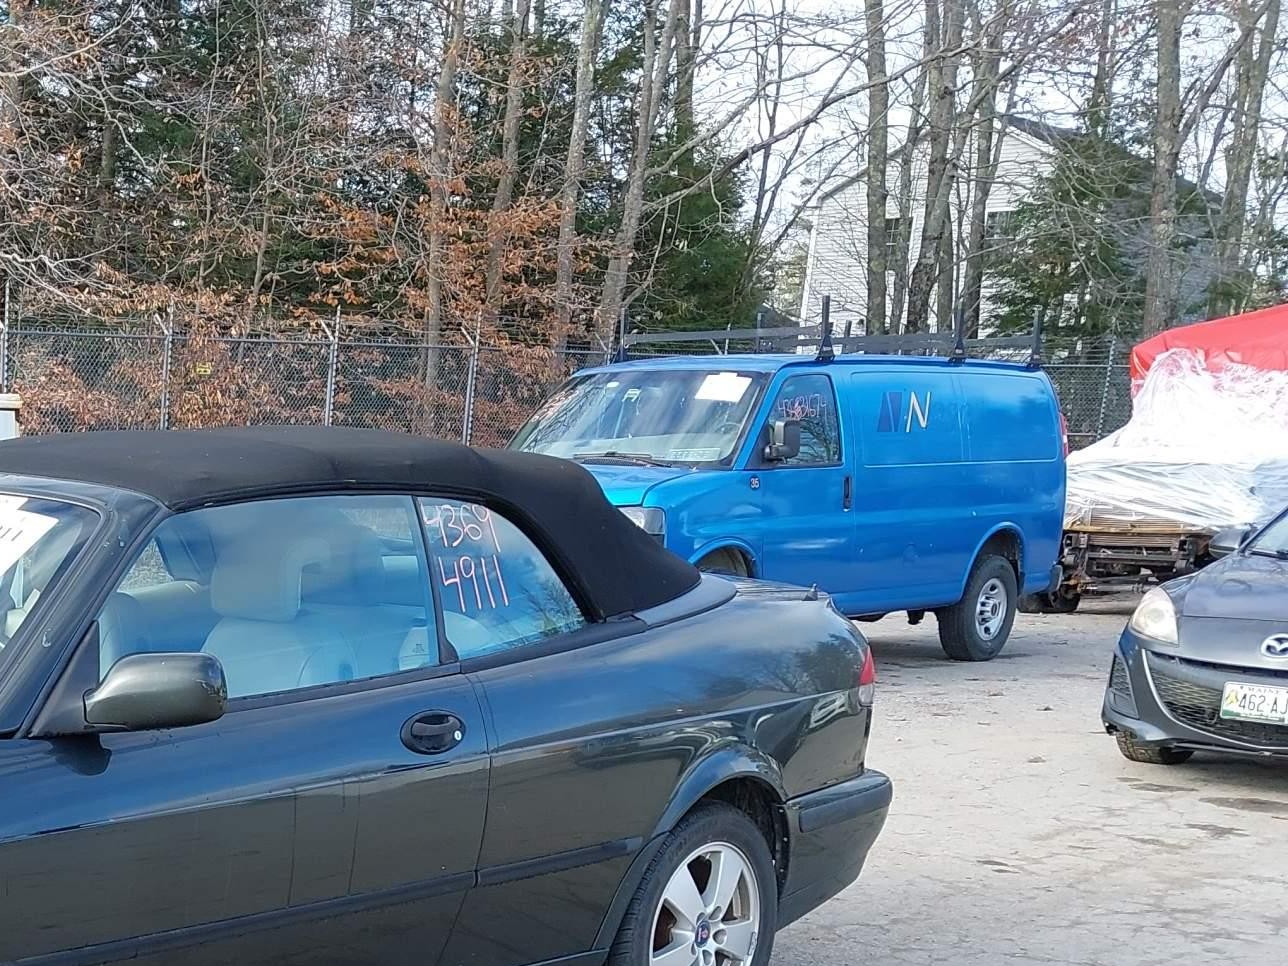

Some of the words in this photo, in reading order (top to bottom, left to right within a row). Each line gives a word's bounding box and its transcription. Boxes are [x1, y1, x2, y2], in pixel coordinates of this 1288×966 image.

[419, 498, 502, 553] 4369
[437, 554, 510, 613] 4911
[1239, 694, 1265, 711] 462
